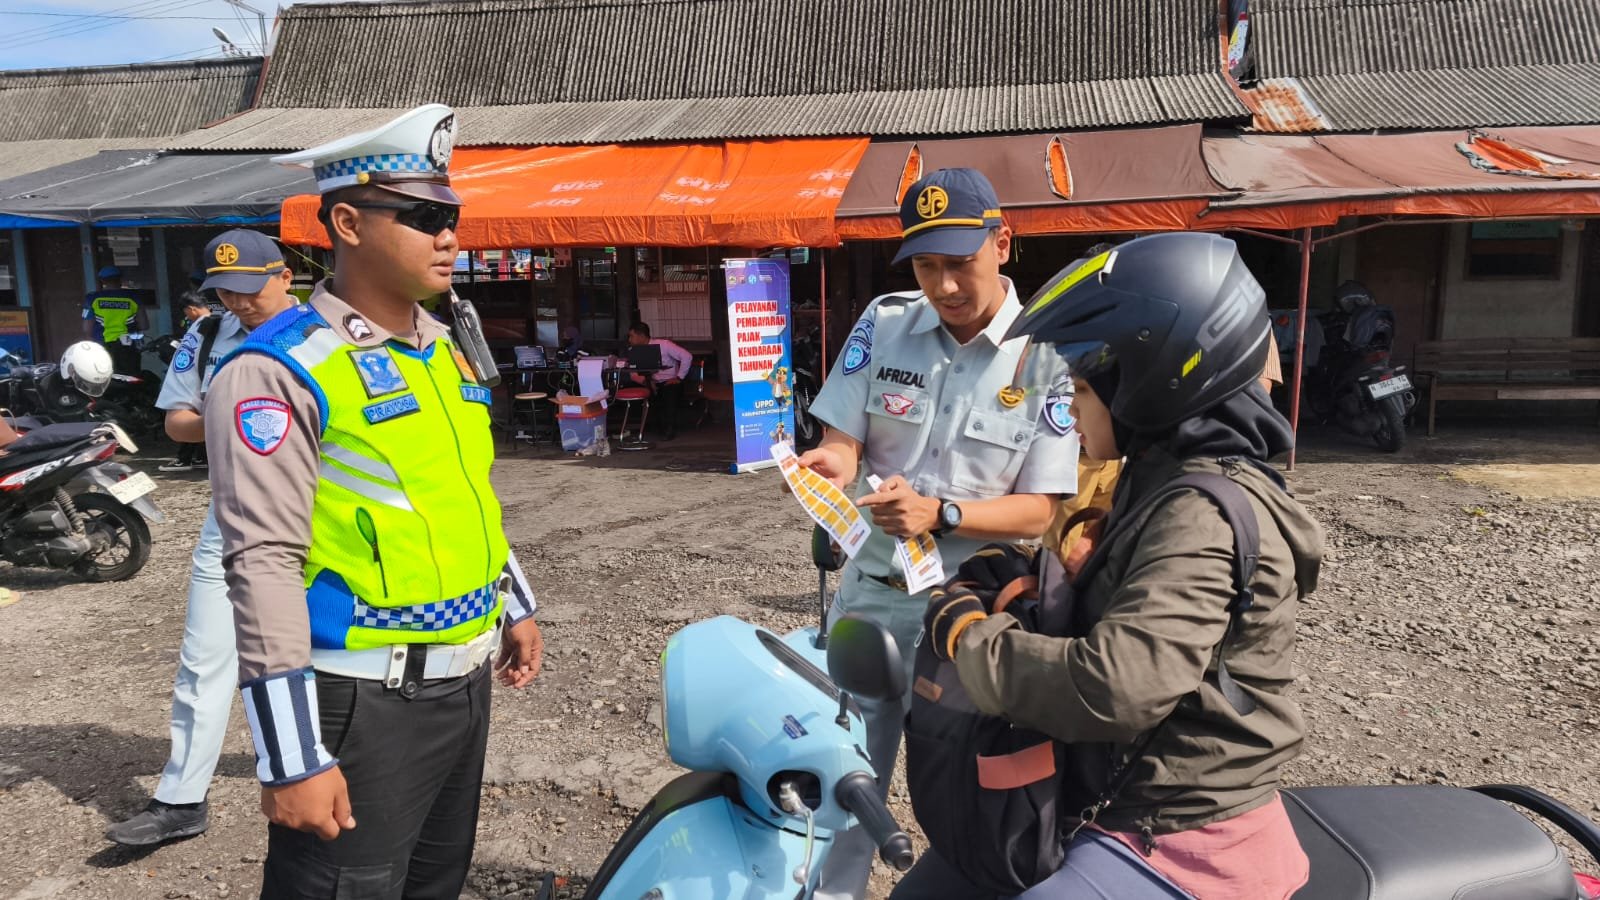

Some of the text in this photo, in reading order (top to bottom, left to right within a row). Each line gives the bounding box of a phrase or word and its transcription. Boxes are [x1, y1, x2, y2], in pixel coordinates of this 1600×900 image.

[735, 301, 777, 313] PELAYANAN
[736, 315, 785, 328] PEMBAYARAN
[737, 331, 761, 343] PAJAK
[738, 344, 782, 358] KENDARAAN
[738, 359, 773, 372] TAHUNAN
[876, 366, 926, 389] AFRIZAL
[366, 397, 416, 421] PRAYOGA
